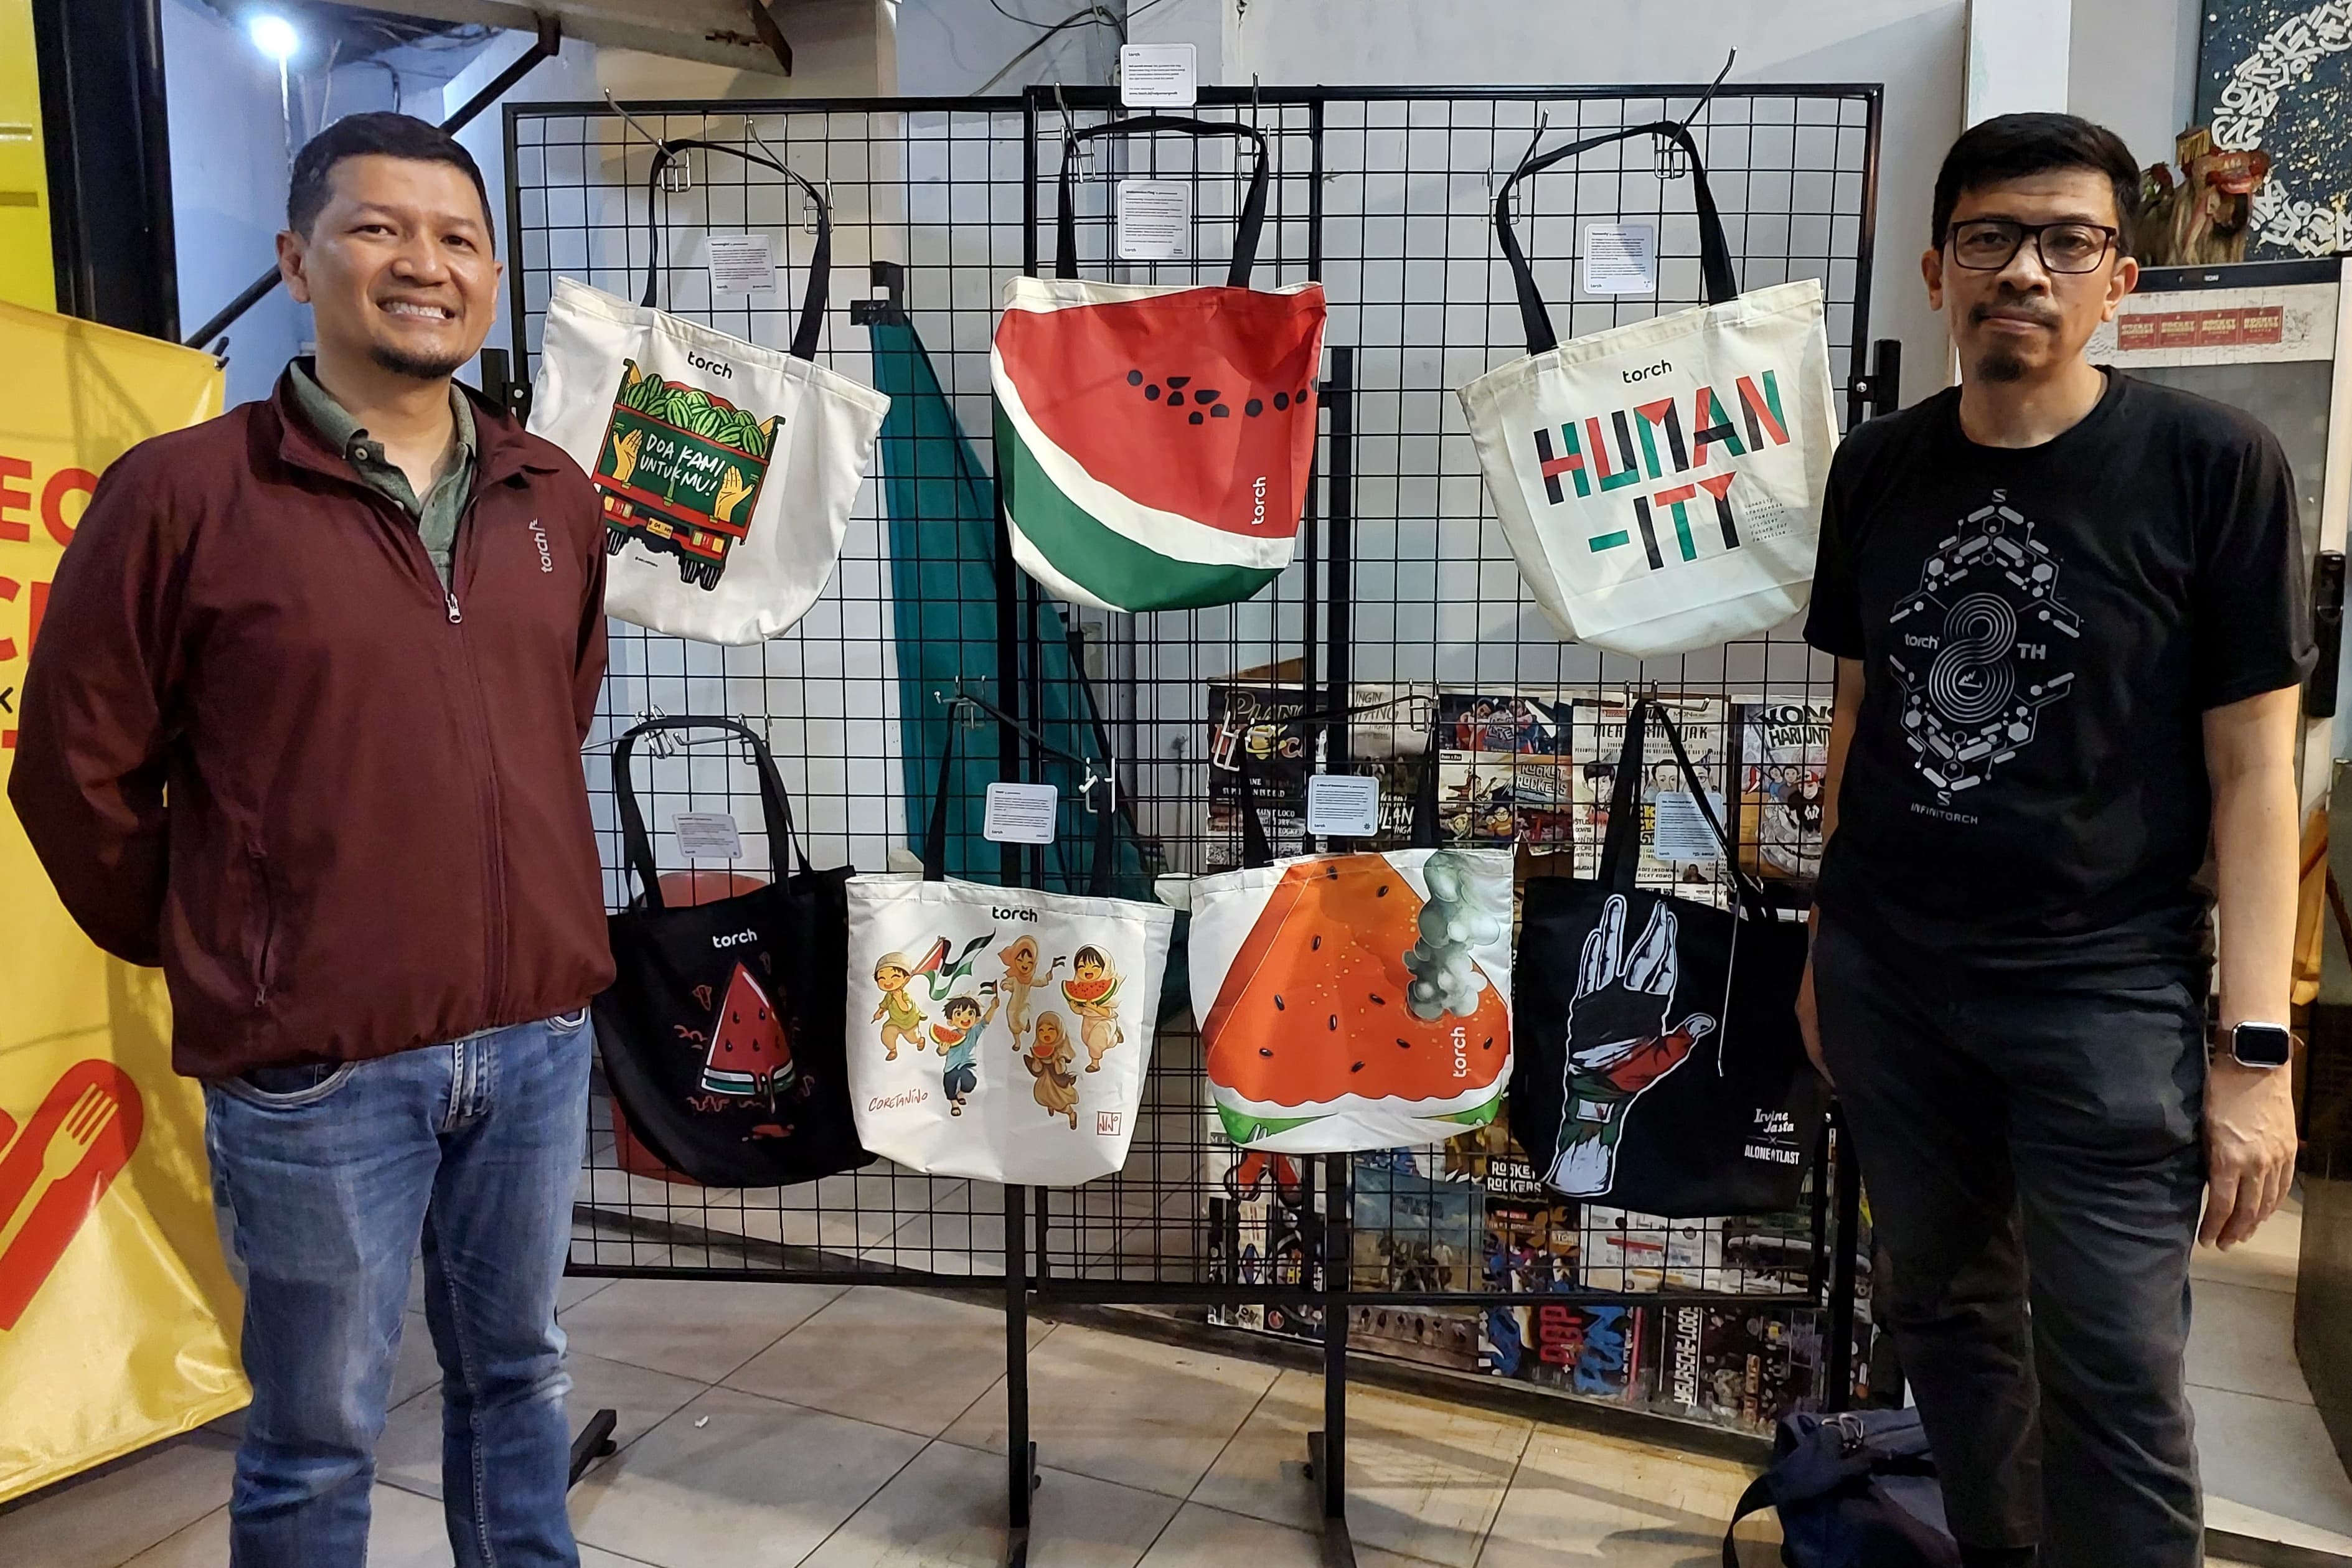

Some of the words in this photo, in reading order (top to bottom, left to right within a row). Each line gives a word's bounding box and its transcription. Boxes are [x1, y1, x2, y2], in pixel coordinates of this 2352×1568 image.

[687, 350, 733, 379] torch
[1622, 359, 1673, 384] torch
[1533, 369, 1790, 505] HUMAN
[646, 433, 675, 460] DOA
[674, 444, 726, 477] KAMI
[1251, 476, 1267, 525] torch
[534, 532, 553, 573] torch
[1904, 632, 1940, 650] torch
[2016, 642, 2046, 660] TH
[1803, 726, 1830, 751] UNT
[1277, 809, 1295, 818] LOCO
[1910, 802, 1978, 825] INFINITORCH
[992, 906, 1038, 923] torch
[712, 927, 758, 949] torch
[1449, 1026, 1467, 1077] torch
[1753, 1108, 1789, 1123] Irvine
[1762, 1120, 1794, 1133] Jasta
[1487, 1176, 1542, 1193] ROCKERS
